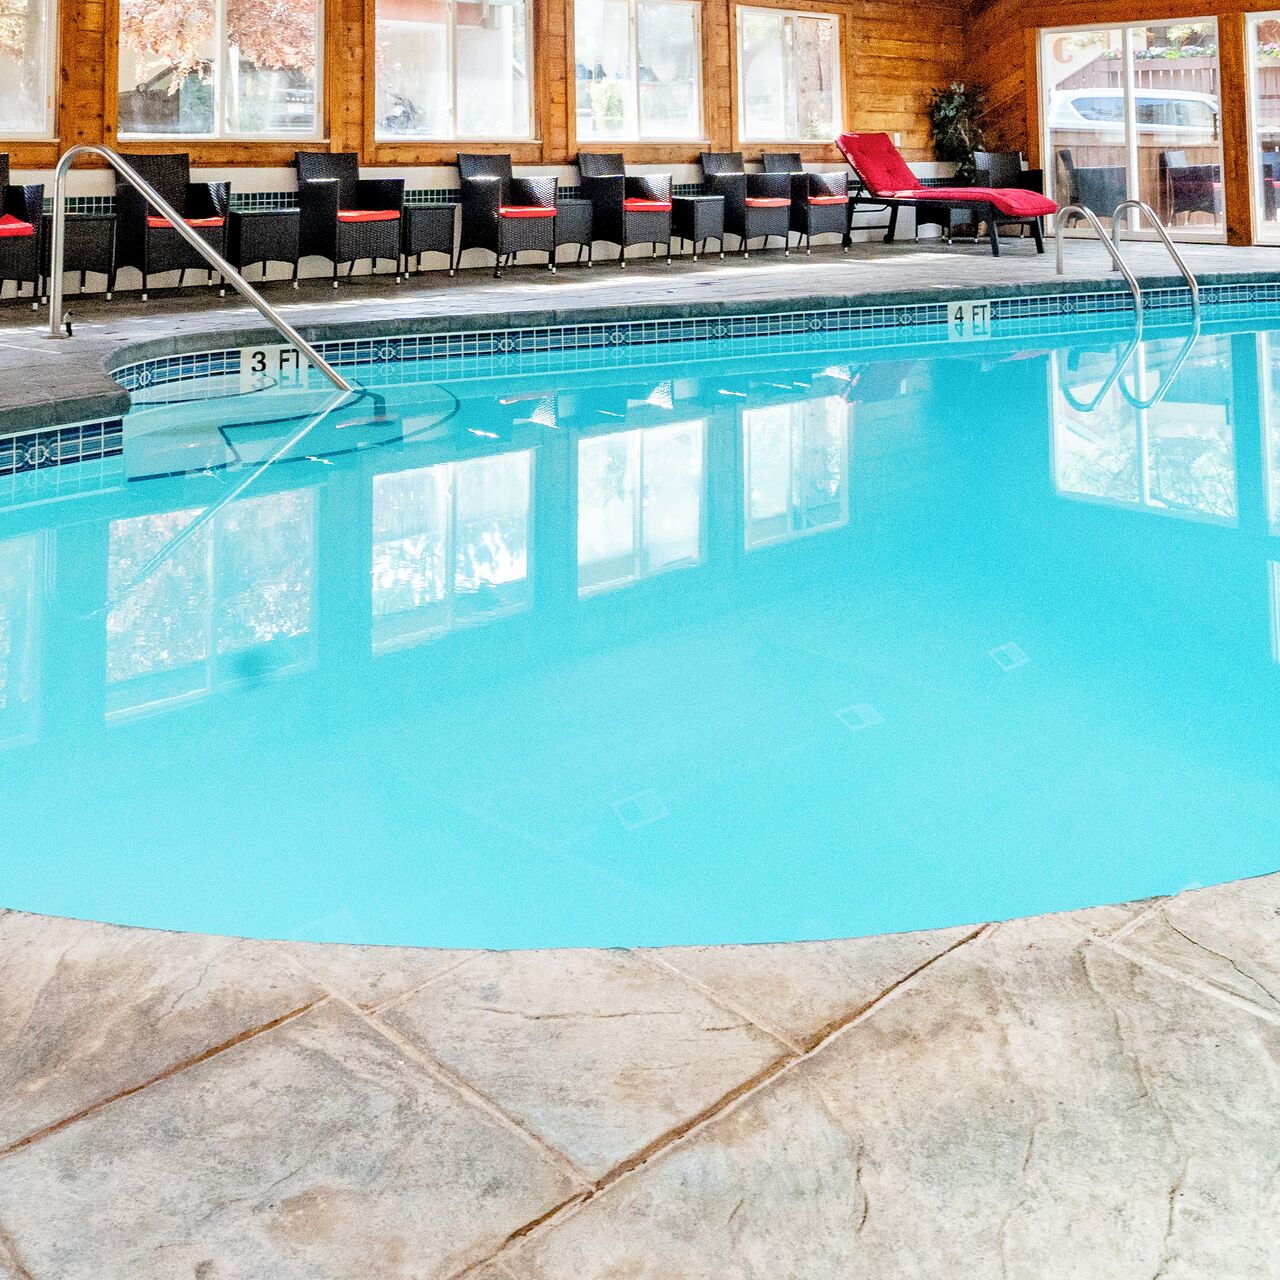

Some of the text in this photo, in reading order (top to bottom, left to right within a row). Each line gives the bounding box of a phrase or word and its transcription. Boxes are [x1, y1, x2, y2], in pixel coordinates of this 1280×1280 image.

[954, 304, 987, 322] 4 FT
[251, 350, 266, 372] 3
